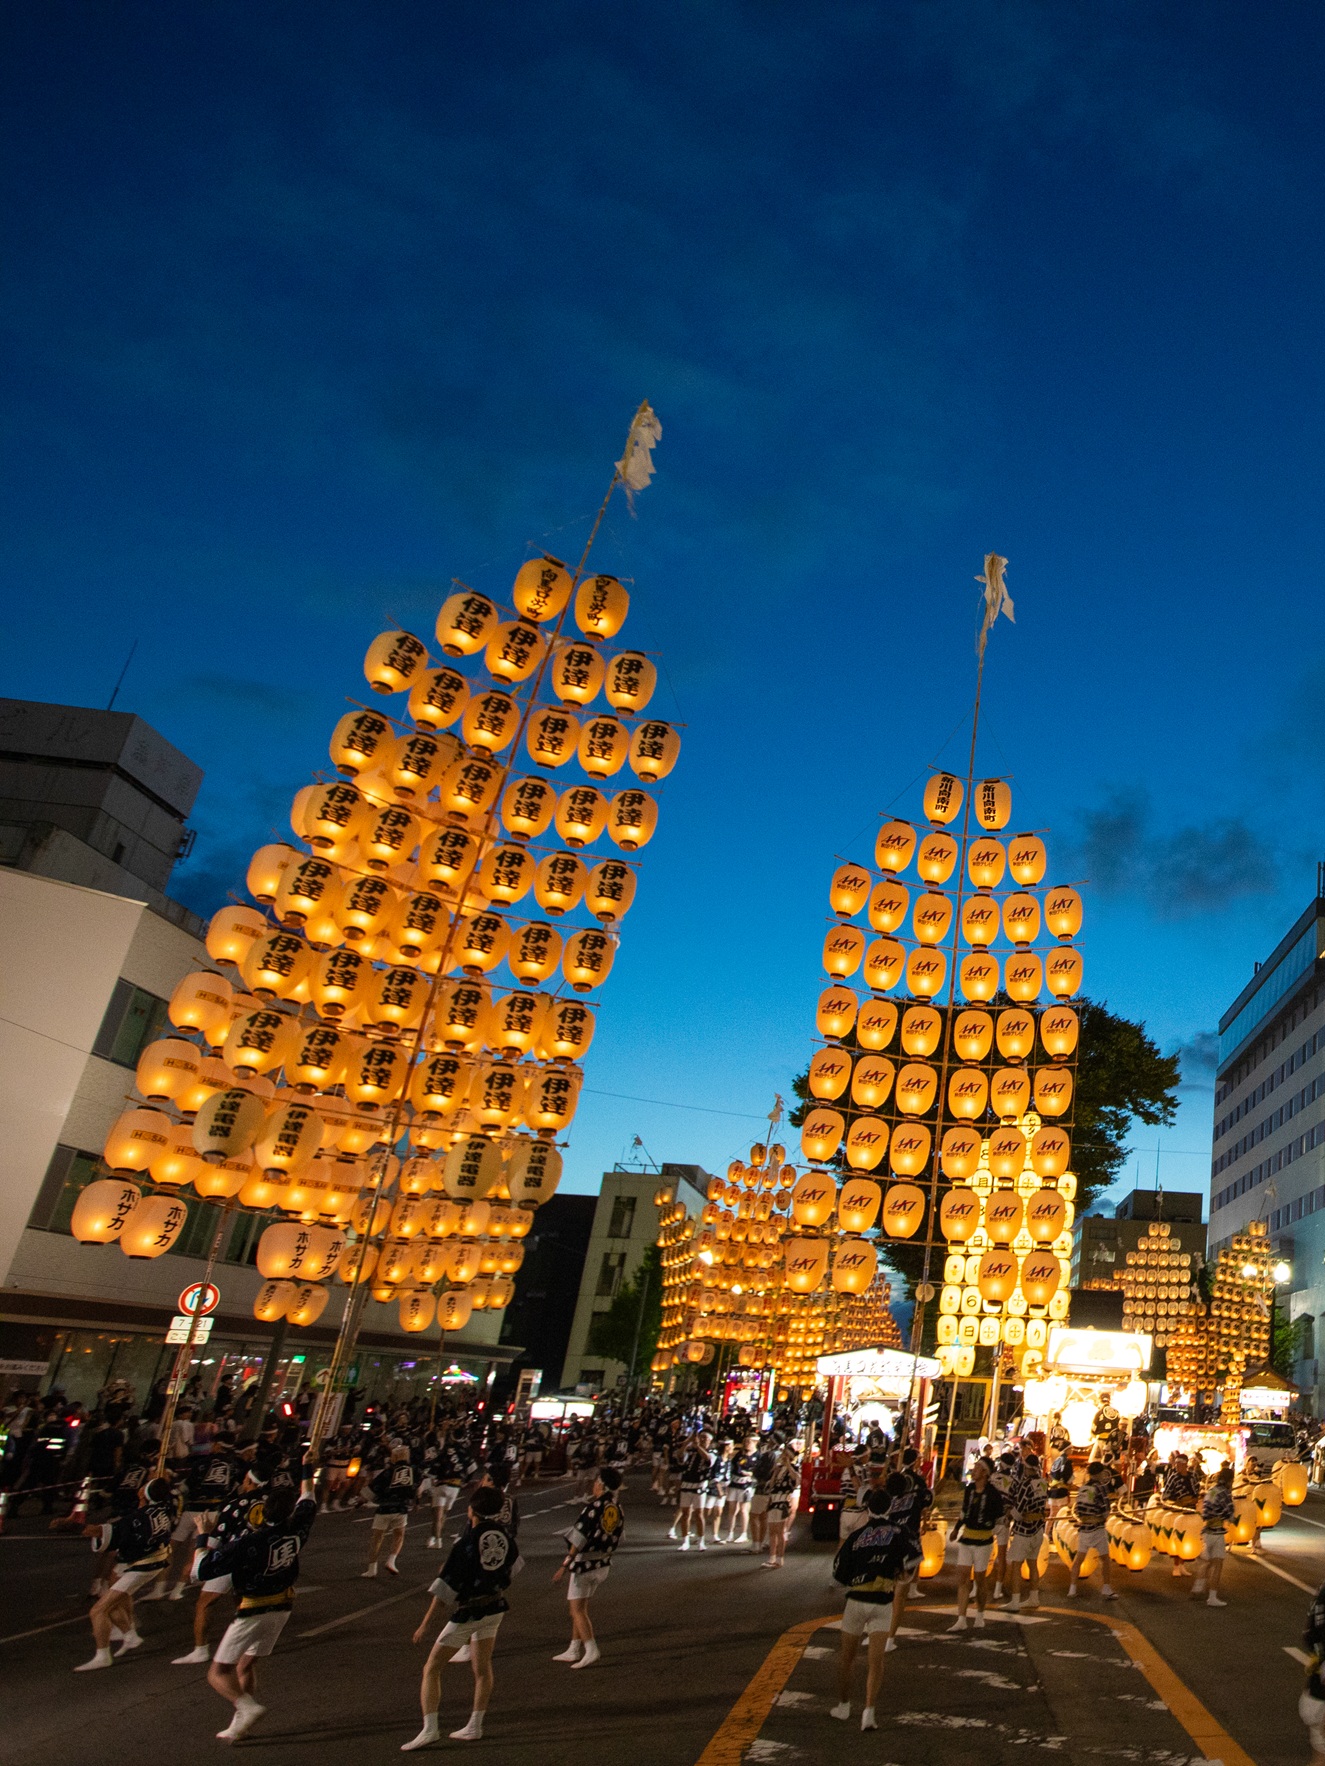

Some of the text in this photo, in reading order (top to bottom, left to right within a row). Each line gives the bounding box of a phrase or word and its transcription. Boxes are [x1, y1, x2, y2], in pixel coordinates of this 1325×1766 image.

[452, 597, 491, 638] 伊達
[385, 635, 424, 677] 伊達
[503, 626, 537, 668] 伊達
[563, 649, 594, 686] 伊達
[614, 658, 644, 696] 伊達
[425, 672, 463, 713] 伊達
[478, 695, 512, 736] 伊達
[344, 714, 386, 757] 伊達
[537, 716, 569, 756] 伊達
[587, 722, 618, 761] 伊達
[638, 722, 669, 760] 伊達
[403, 738, 438, 778] 伊達
[457, 763, 492, 803] 伊達
[513, 782, 546, 821] 伊達
[935, 776, 954, 813] 新川向南町
[317, 785, 359, 826] 伊達
[566, 790, 598, 826] 伊達
[617, 793, 646, 830] 伊達
[983, 785, 996, 822] 新川向南町
[375, 809, 411, 849] 伊達
[432, 831, 469, 870] 伊達
[493, 850, 525, 889] 伊達
[289, 860, 332, 900] 伊達
[548, 857, 578, 895] 伊達
[597, 864, 628, 901] 伊達
[347, 878, 388, 915] 伊達
[407, 896, 442, 934] 伊達
[467, 916, 501, 953] 伊達
[520, 928, 552, 962] 伊達
[577, 934, 603, 972] 伊達
[262, 935, 303, 976] 伊達
[324, 952, 363, 990] 伊達
[380, 970, 417, 1008] 伊達
[449, 988, 482, 1028] 伊達
[238, 1012, 282, 1052] 伊達
[506, 996, 536, 1033] 伊達
[558, 1007, 587, 1044] 伊達
[298, 1029, 340, 1069] 伊達
[362, 1048, 397, 1089] 伊達
[424, 1058, 460, 1097] 伊達
[485, 1072, 516, 1107] 伊達
[541, 1078, 571, 1115] 伊達
[457, 1141, 486, 1187] 伊達電器
[523, 1146, 549, 1188] 伊達電器
[107, 1189, 137, 1230] ホサカ
[154, 1206, 182, 1247] ホサカ
[289, 1232, 309, 1268] ホサカ
[317, 1241, 342, 1275] ホサカ
[170, 1333, 205, 1341] ここら
[206, 1463, 228, 1484] 馬
[394, 1468, 412, 1486] 馬
[271, 1540, 295, 1568] 馬
